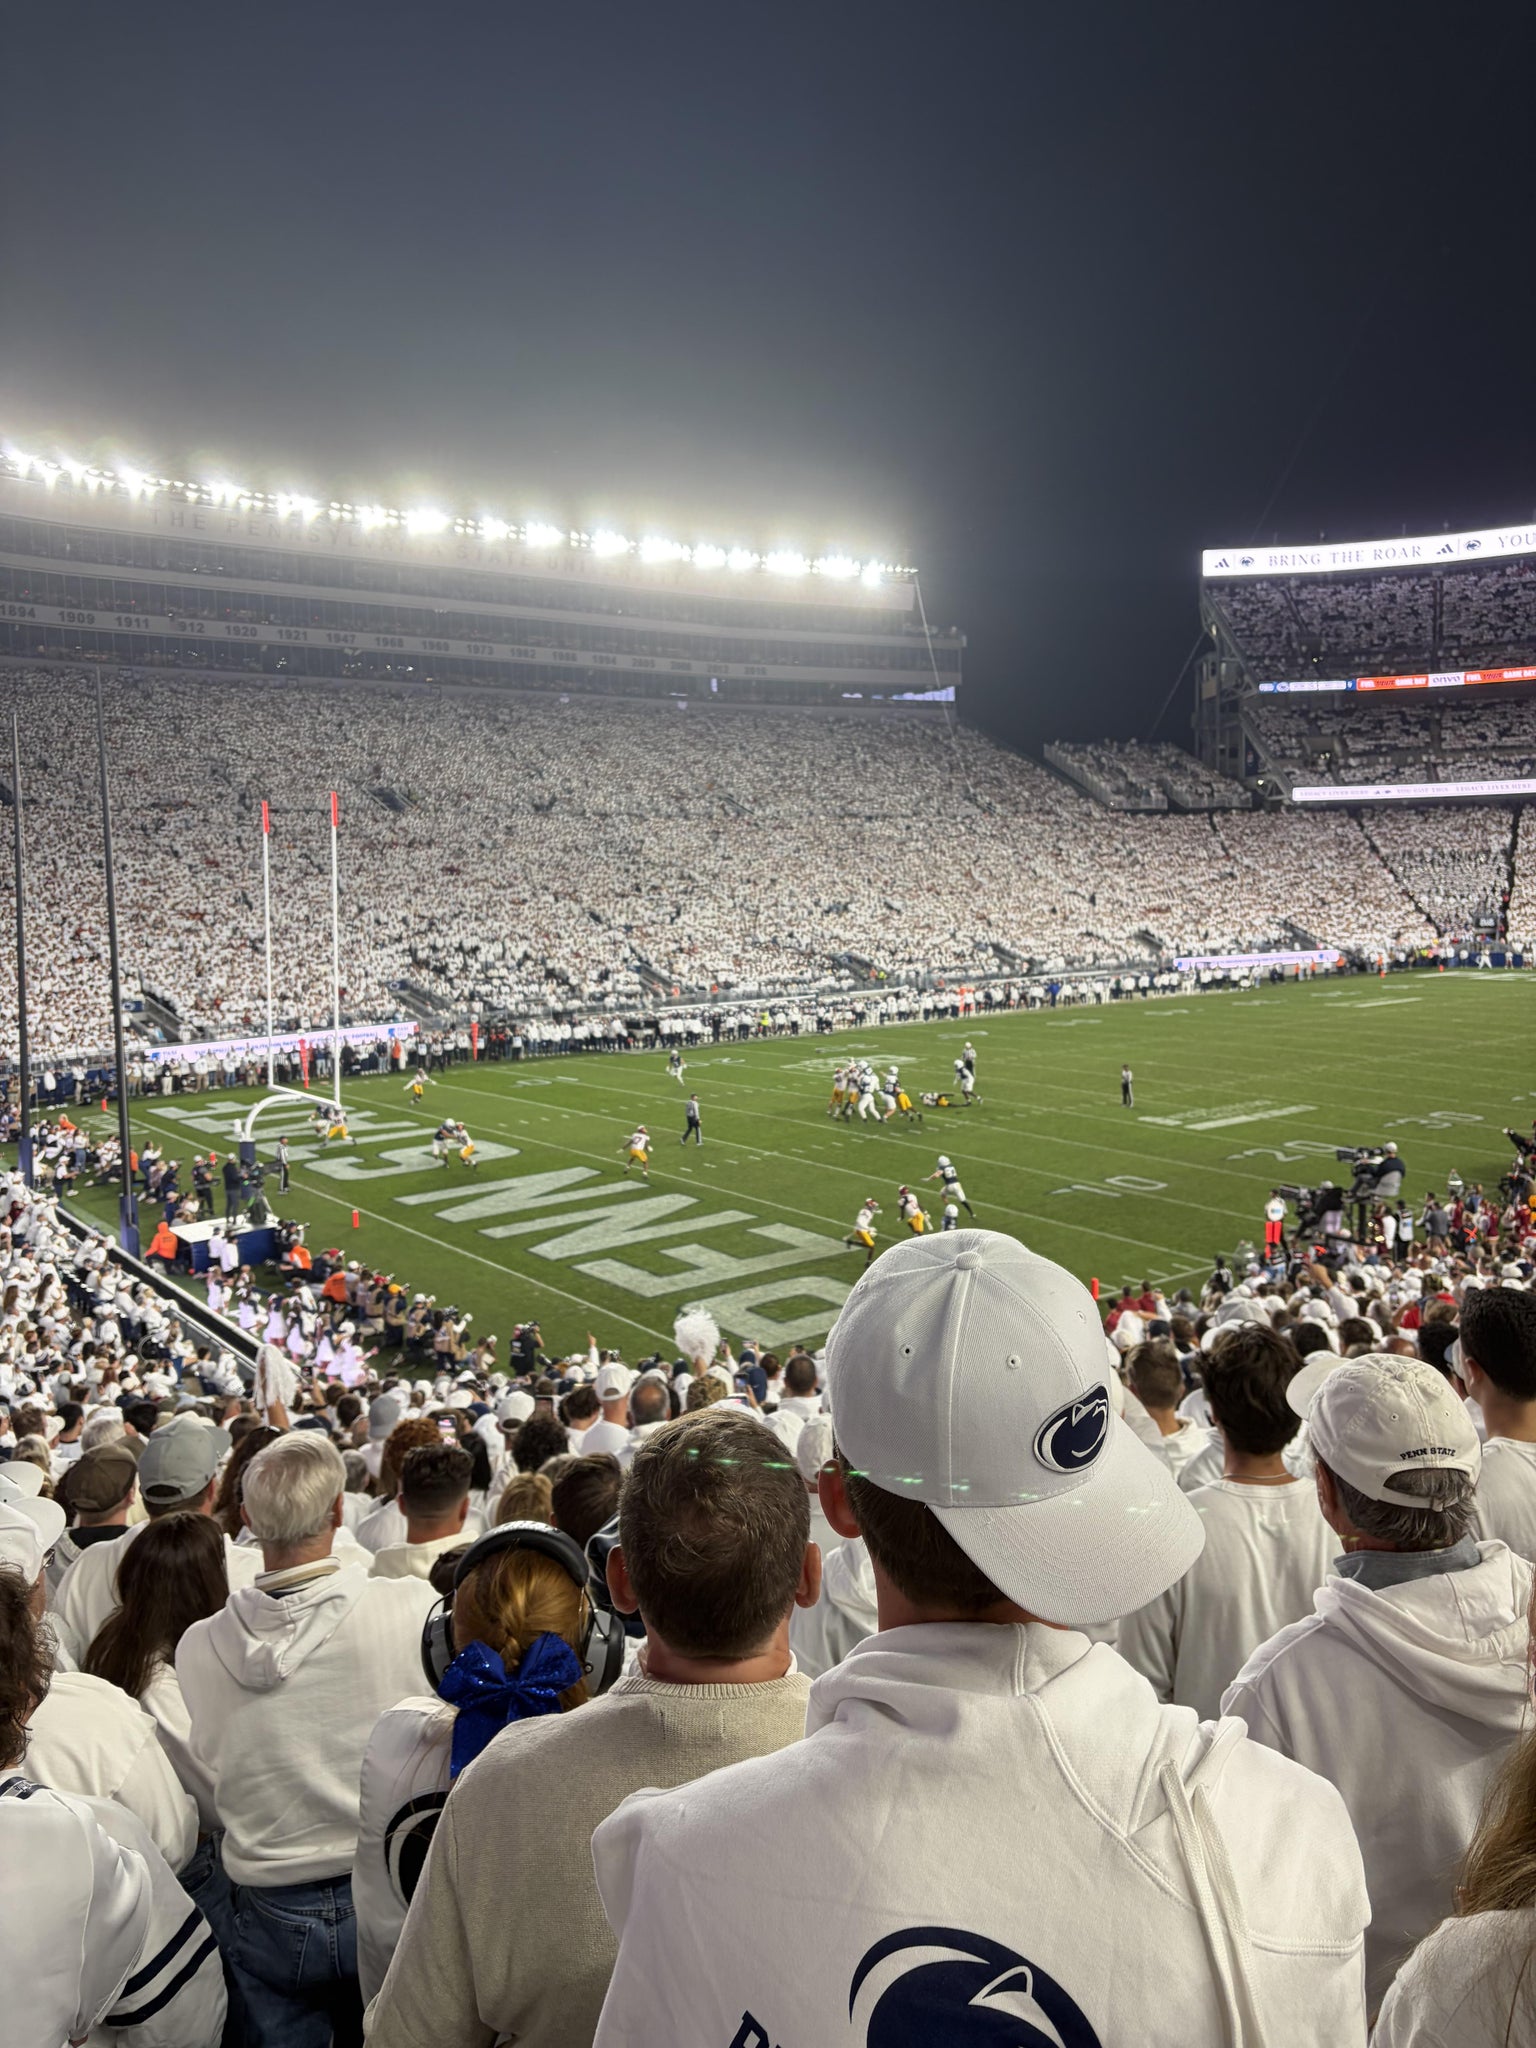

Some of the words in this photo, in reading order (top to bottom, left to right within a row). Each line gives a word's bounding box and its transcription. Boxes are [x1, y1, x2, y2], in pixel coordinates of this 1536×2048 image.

[150, 508, 206, 530] THE
[226, 516, 440, 557] PENNSYLAA
[1268, 553, 1321, 567] BRING
[1330, 550, 1364, 564] THE
[1373, 545, 1421, 560] ROAR
[0, 603, 37, 619] 1894
[58, 610, 96, 625] 1909
[115, 615, 150, 630] 1911
[225, 624, 258, 638] 1920
[277, 628, 308, 641] 1921
[326, 632, 357, 644] 1947
[1242, 1139, 1340, 1162] 20
[1071, 1175, 1169, 1197] 10
[1400, 1447, 1428, 1460] PENN
[1430, 1447, 1456, 1457] STATE
